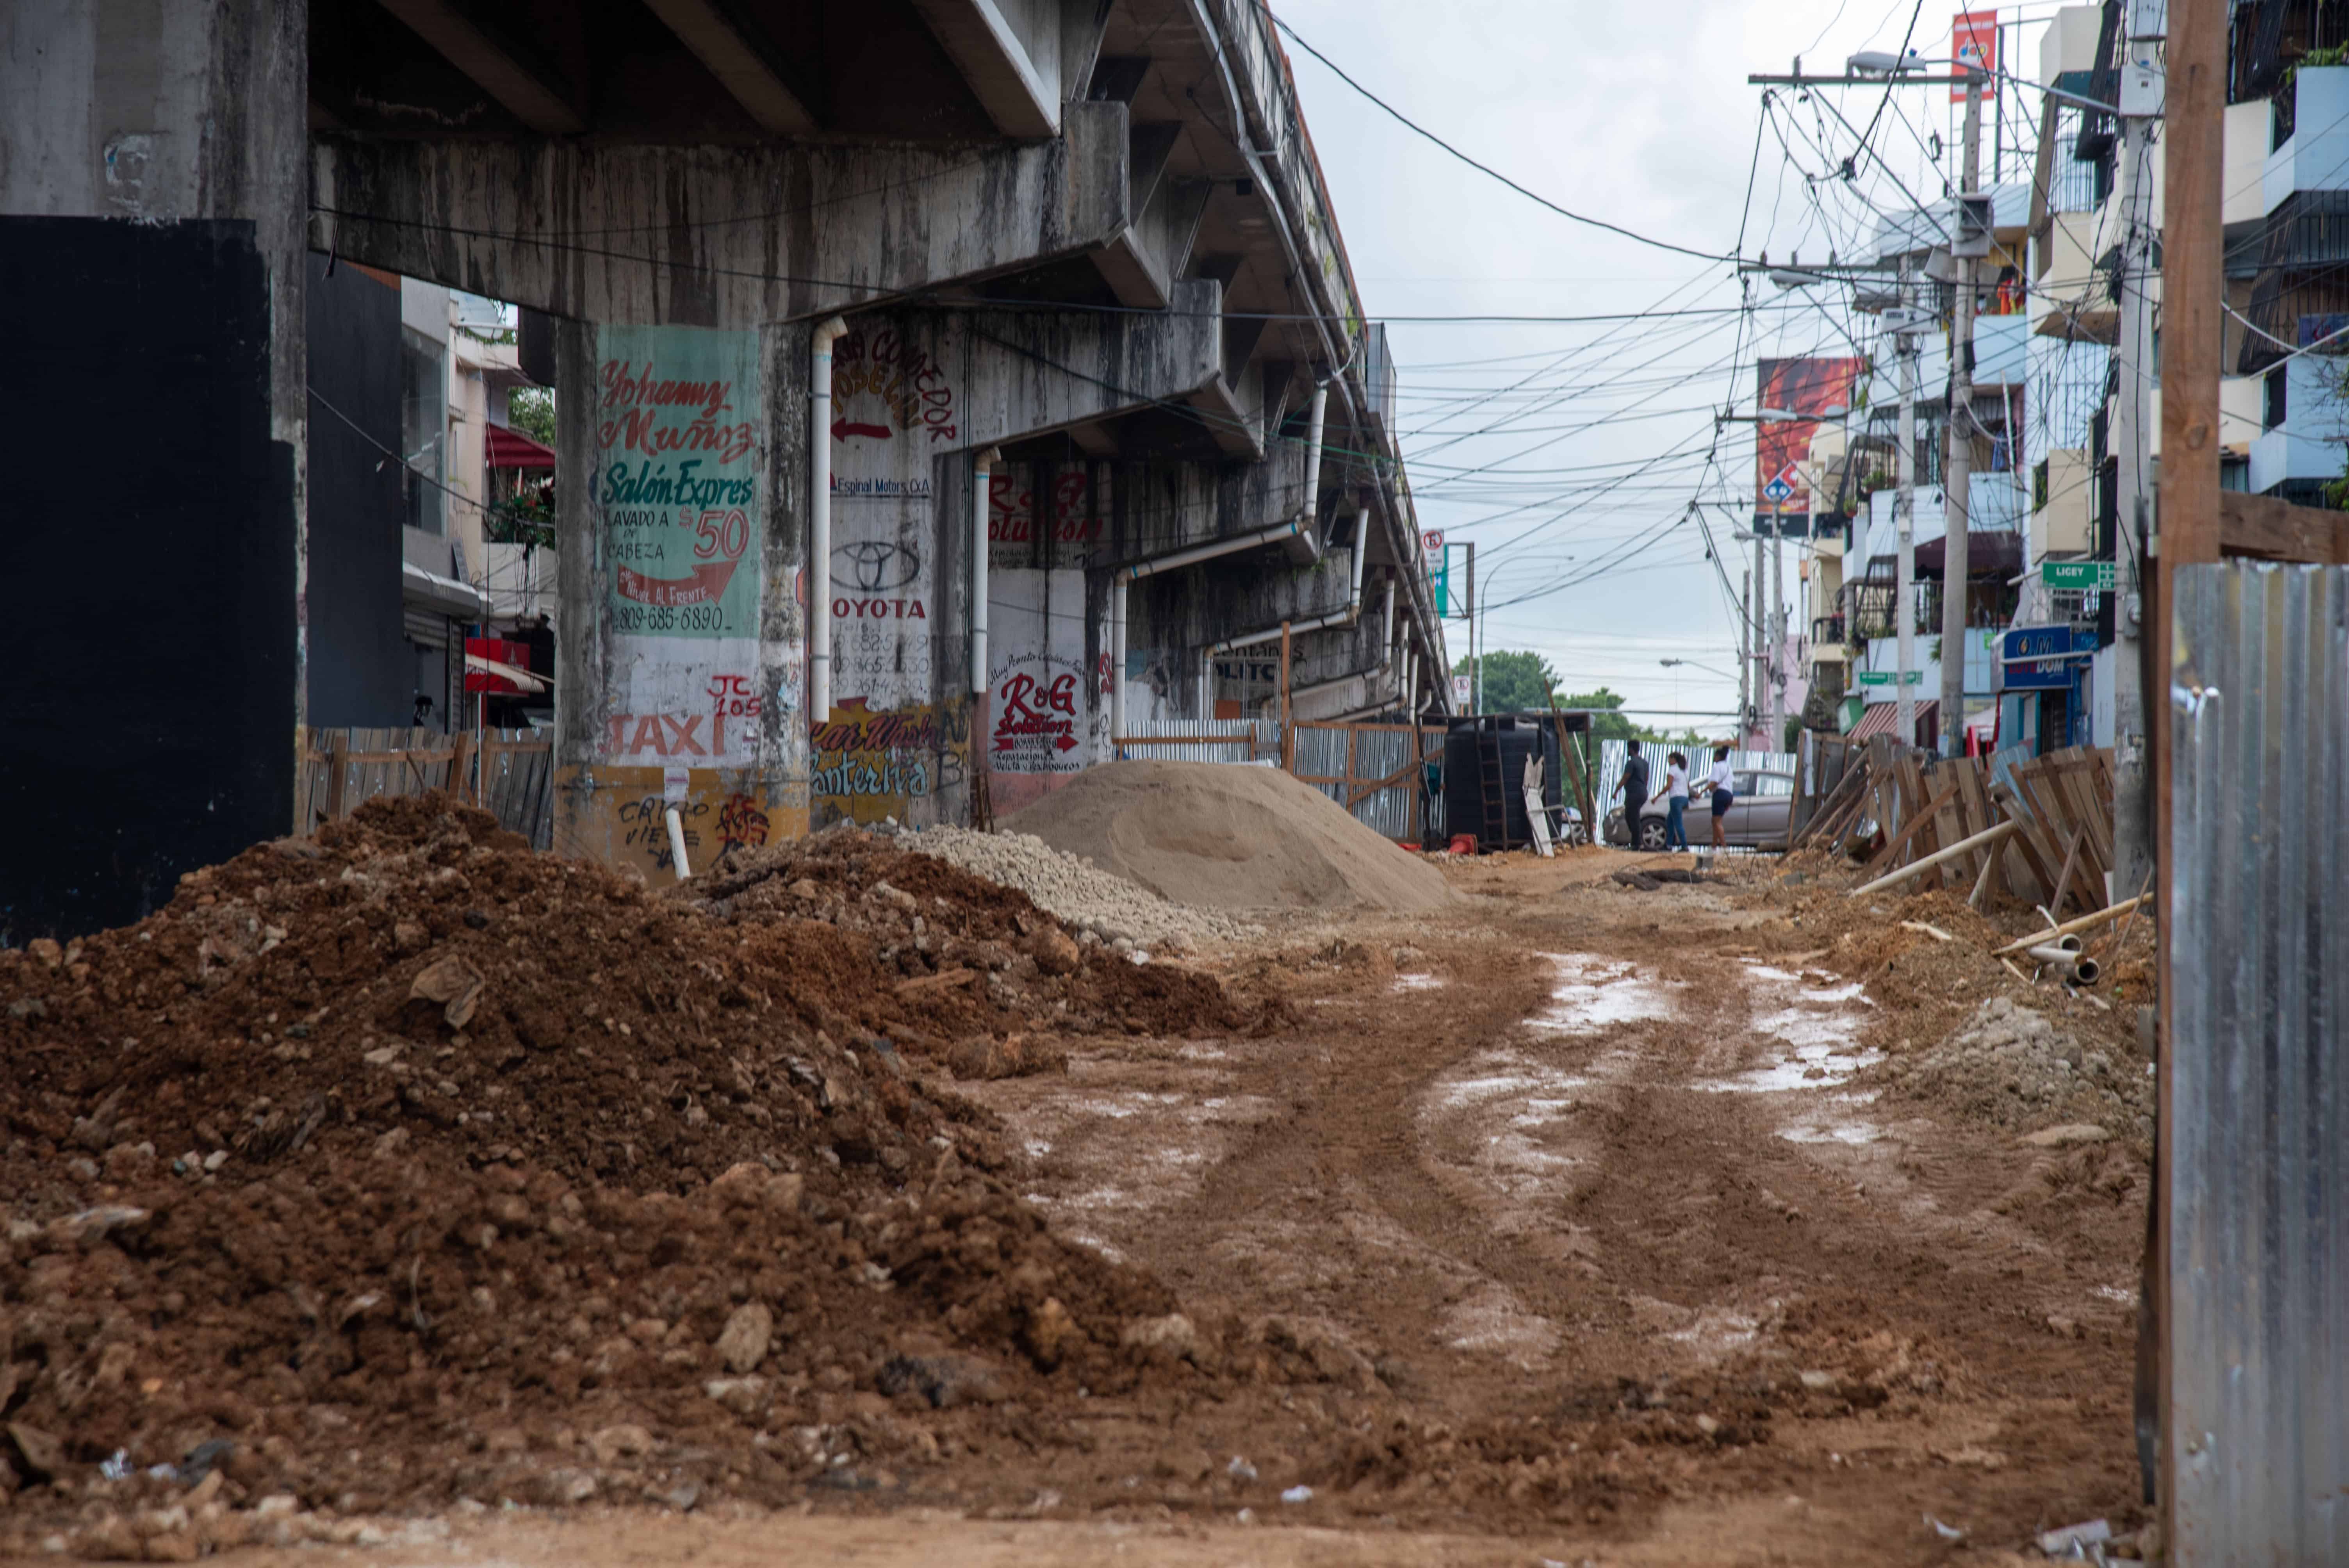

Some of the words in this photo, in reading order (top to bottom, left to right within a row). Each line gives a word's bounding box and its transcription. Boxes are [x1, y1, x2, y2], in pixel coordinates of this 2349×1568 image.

[598, 408, 756, 464] Muñoz
[602, 460, 674, 505] Salón
[674, 459, 753, 511] Expres
[838, 478, 872, 495] Espinal
[659, 511, 669, 527] A
[608, 543, 664, 561] CABEZA
[2056, 567, 2084, 577] LICEY
[832, 599, 926, 619] OYOTA
[609, 714, 725, 756] TAXI
